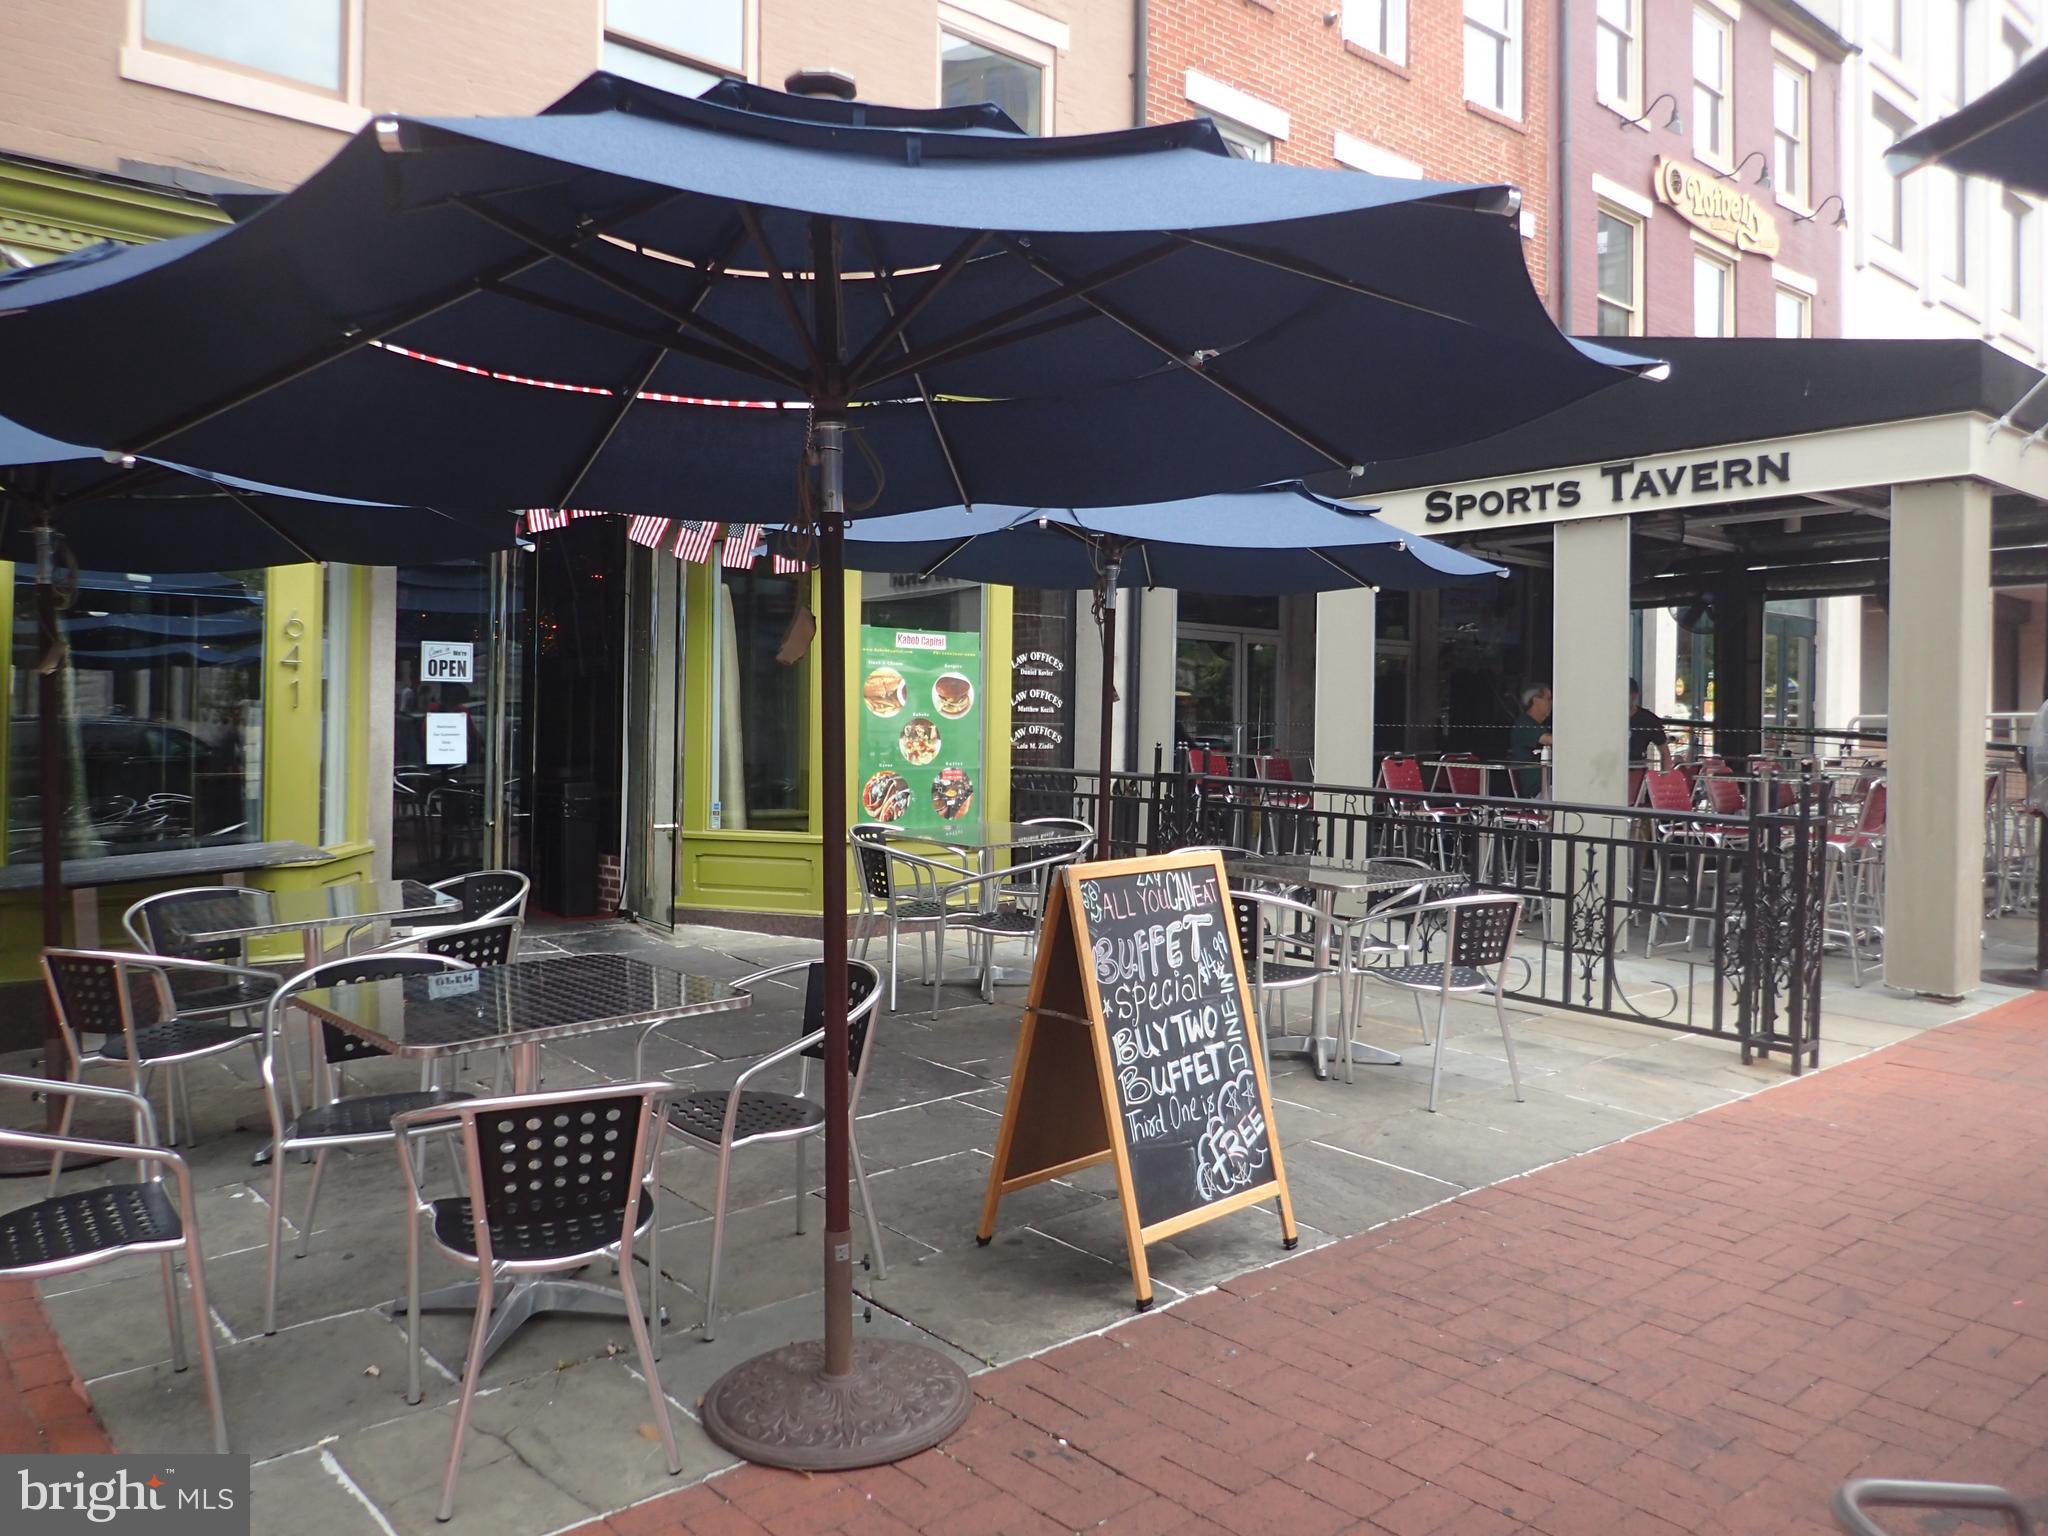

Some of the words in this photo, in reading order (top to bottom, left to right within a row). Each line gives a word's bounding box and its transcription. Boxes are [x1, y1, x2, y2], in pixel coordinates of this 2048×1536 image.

[1425, 480, 1581, 523] SPORTS
[1601, 452, 1790, 501] TAVERN
[280, 608, 304, 710] 641
[898, 634, 920, 645] Kabob
[921, 636, 945, 647] Capital
[1011, 653, 1028, 669] LAW
[1030, 651, 1064, 671] OFFICES
[428, 659, 467, 678] OPEN
[1010, 690, 1027, 706] LAW
[1029, 689, 1063, 709] OFFICES
[1010, 727, 1026, 743] LAW
[1029, 725, 1062, 744] OFFICES
[1103, 889, 1136, 920] ALL
[1136, 887, 1170, 916] YOU
[1165, 872, 1196, 911] CAN
[1192, 878, 1217, 907] EAT
[1092, 914, 1213, 984] BUFFET
[1112, 1016, 1168, 1066] BUY
[1169, 1005, 1218, 1048] TWO
[1118, 1041, 1226, 1106] BUFFET
[1126, 1103, 1168, 1144] Third
[1169, 1095, 1201, 1130] One
